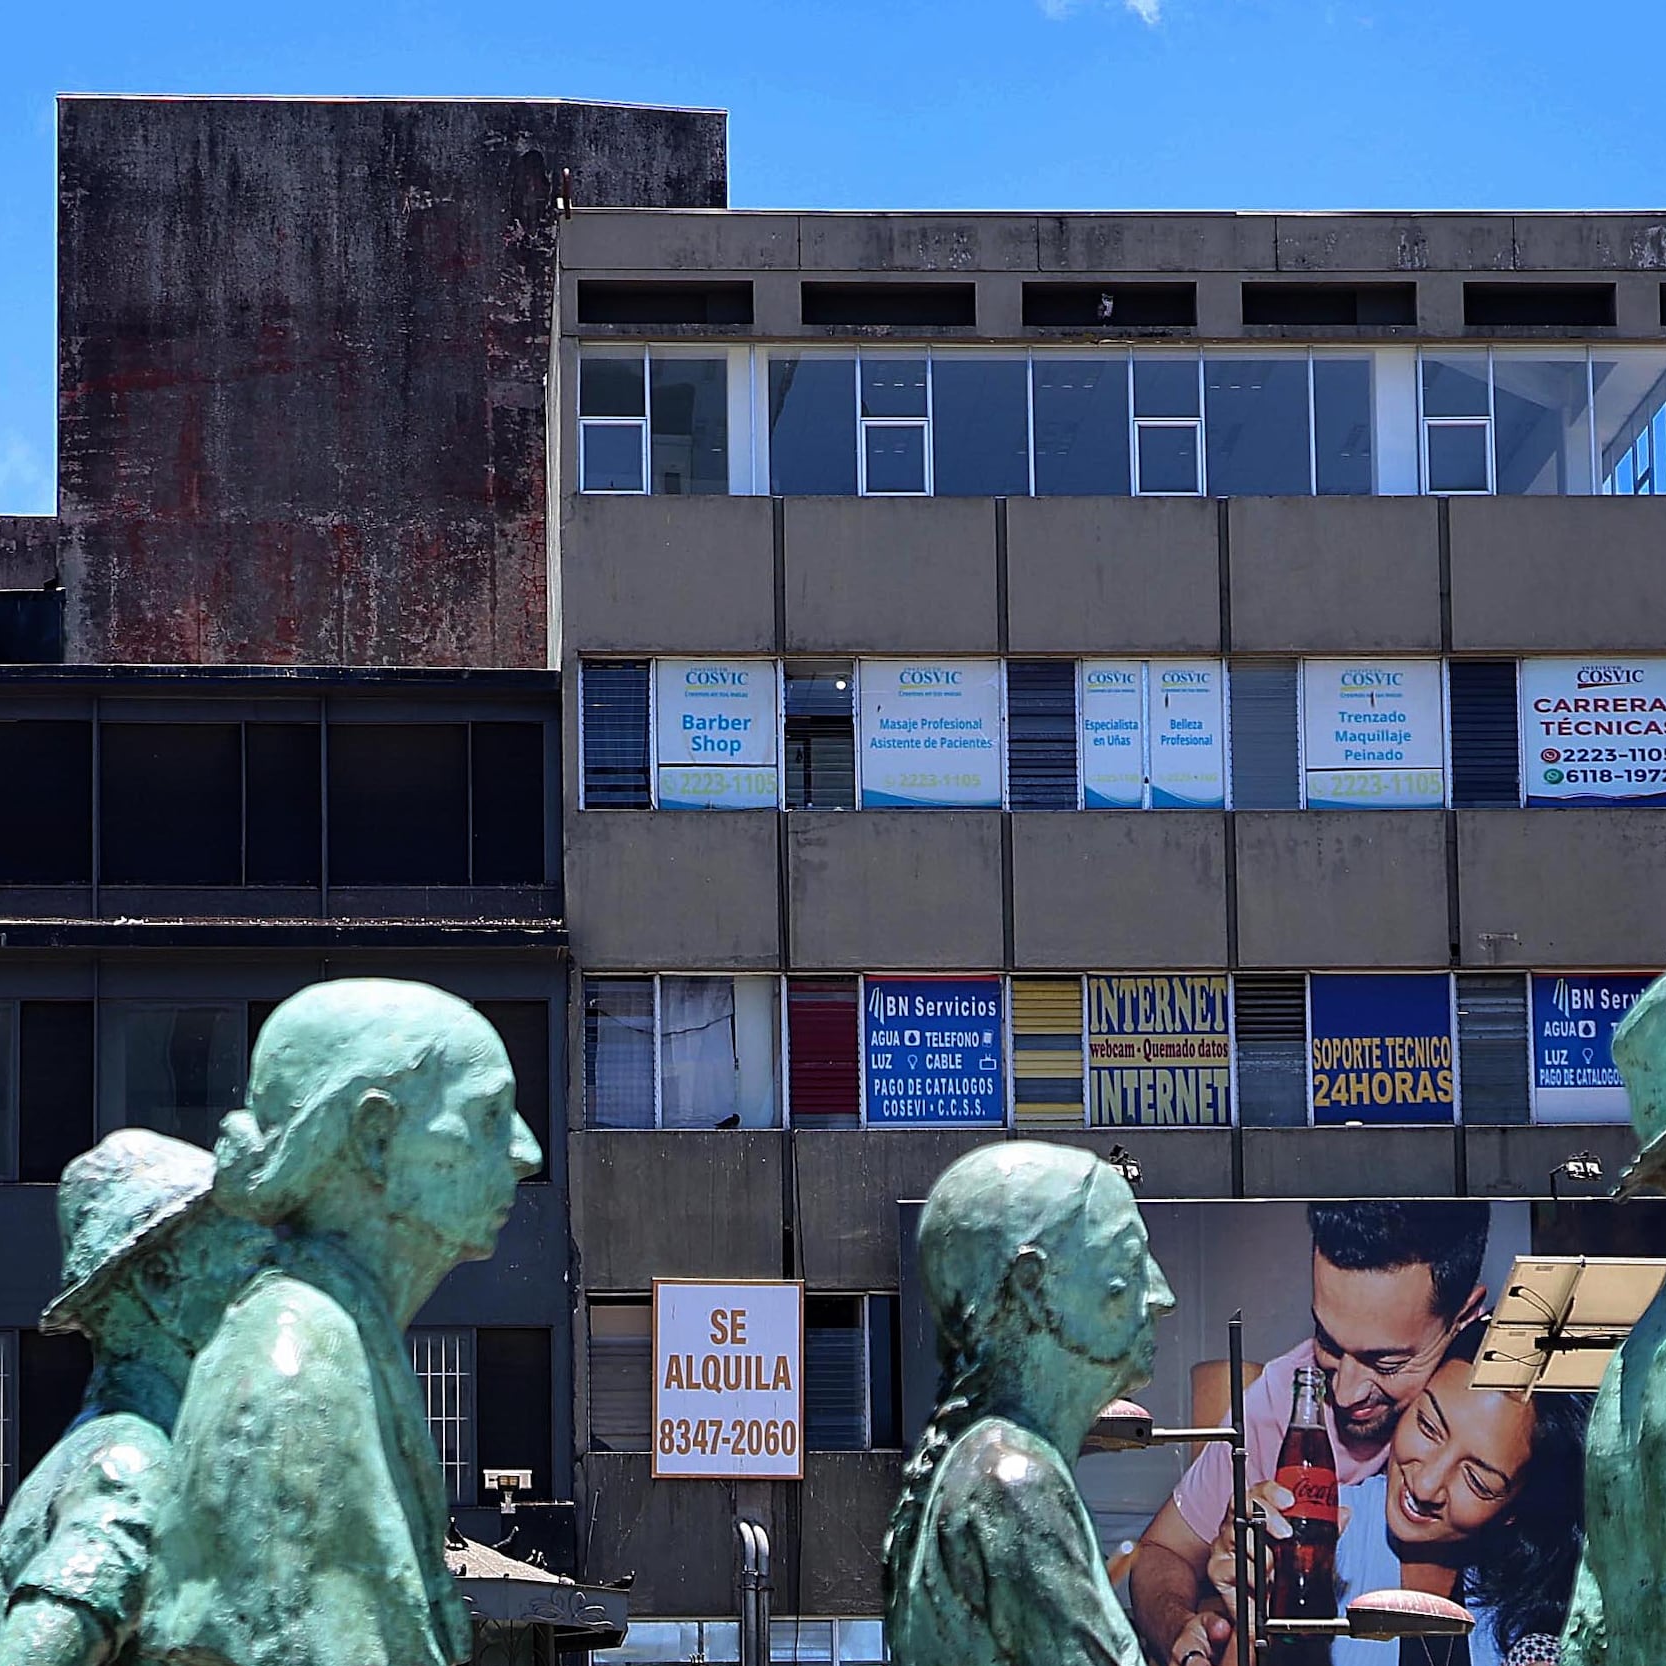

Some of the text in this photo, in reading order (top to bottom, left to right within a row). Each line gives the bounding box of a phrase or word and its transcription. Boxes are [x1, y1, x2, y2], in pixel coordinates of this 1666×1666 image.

[685, 671, 749, 685] COSVIC
[899, 671, 963, 685] COSVIC
[1087, 672, 1136, 684] COSVIC
[1161, 672, 1211, 684] COSVIC
[1341, 672, 1404, 686] COSVIC
[1577, 669, 1644, 683] COSVIC
[682, 714, 751, 731] Barber
[1170, 719, 1203, 730] Belleza
[1338, 710, 1407, 723] Trenzado
[879, 717, 982, 733] Masaje Profesional
[1085, 719, 1139, 733] Especialista
[870, 736, 993, 749] Asistente de Pacientes
[1093, 735, 1131, 747] en Uñas
[1160, 734, 1213, 746] Profesional
[1335, 729, 1412, 744] Maquillaje
[691, 735, 741, 756] Shop
[1345, 749, 1403, 761] Peinado
[680, 773, 777, 795] 2223-1105
[1330, 772, 1443, 796] 2223-1105
[886, 996, 997, 1016] BN Servicios
[1089, 977, 1227, 1033] INTERNET
[1571, 988, 1645, 1009] BN Serv
[1544, 1021, 1577, 1037] AGUA
[871, 1030, 980, 1048] AGUA TELEFONO
[1089, 1038, 1136, 1058] webcam
[1143, 1038, 1196, 1062] Quemado
[1198, 1038, 1228, 1058] datos
[1313, 1035, 1451, 1070] SOPORTE TECNICO
[1545, 1050, 1569, 1065] LUZ
[871, 1053, 963, 1069] LUZ CABLE
[1539, 1069, 1562, 1086] PAGO
[1564, 1069, 1575, 1085] DE
[874, 1077, 994, 1096] PAGO DE CATALOGOS
[1314, 1069, 1453, 1107] 24HORAS
[1090, 1068, 1229, 1125] INTERNET
[883, 1098, 986, 1117] COSEVI C.C.S.S.
[710, 1308, 747, 1345] SE
[664, 1354, 792, 1394] ALQUILA
[659, 1418, 797, 1456] 8347-2060
